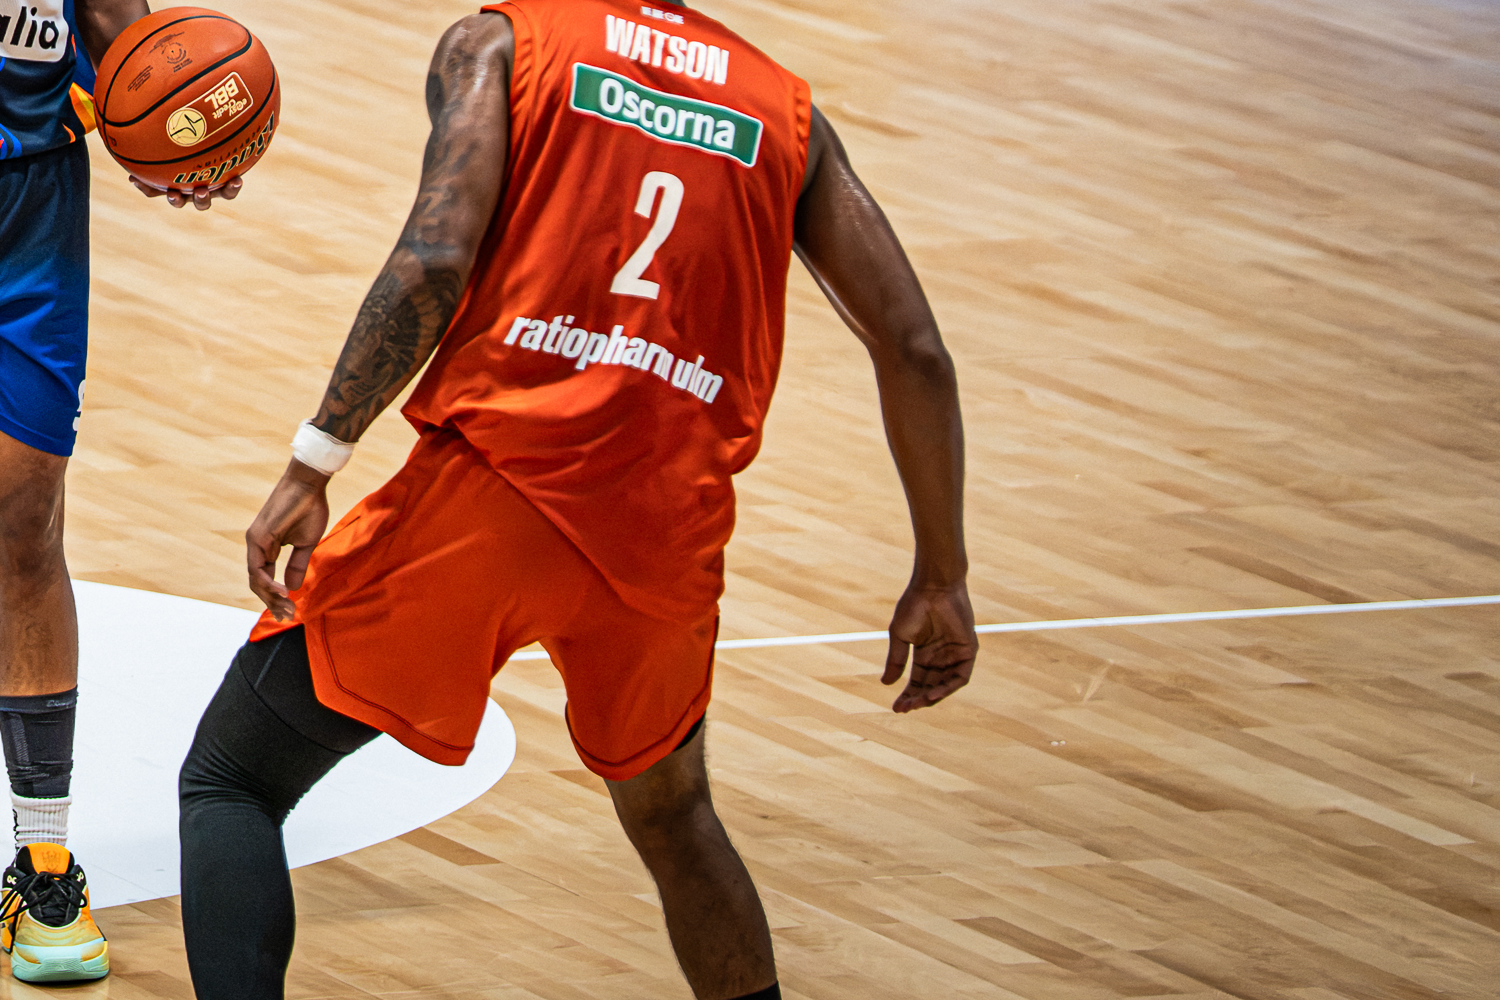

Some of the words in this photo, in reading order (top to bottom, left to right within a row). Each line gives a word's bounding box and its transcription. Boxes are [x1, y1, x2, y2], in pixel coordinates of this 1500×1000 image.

[605, 14, 730, 86] WATSON
[204, 77, 240, 110] BBL
[212, 98, 236, 120] Credit
[599, 76, 737, 150] Oscorna
[172, 110, 275, 184] Baden
[609, 170, 685, 300] 2
[670, 354, 724, 405] ulm
